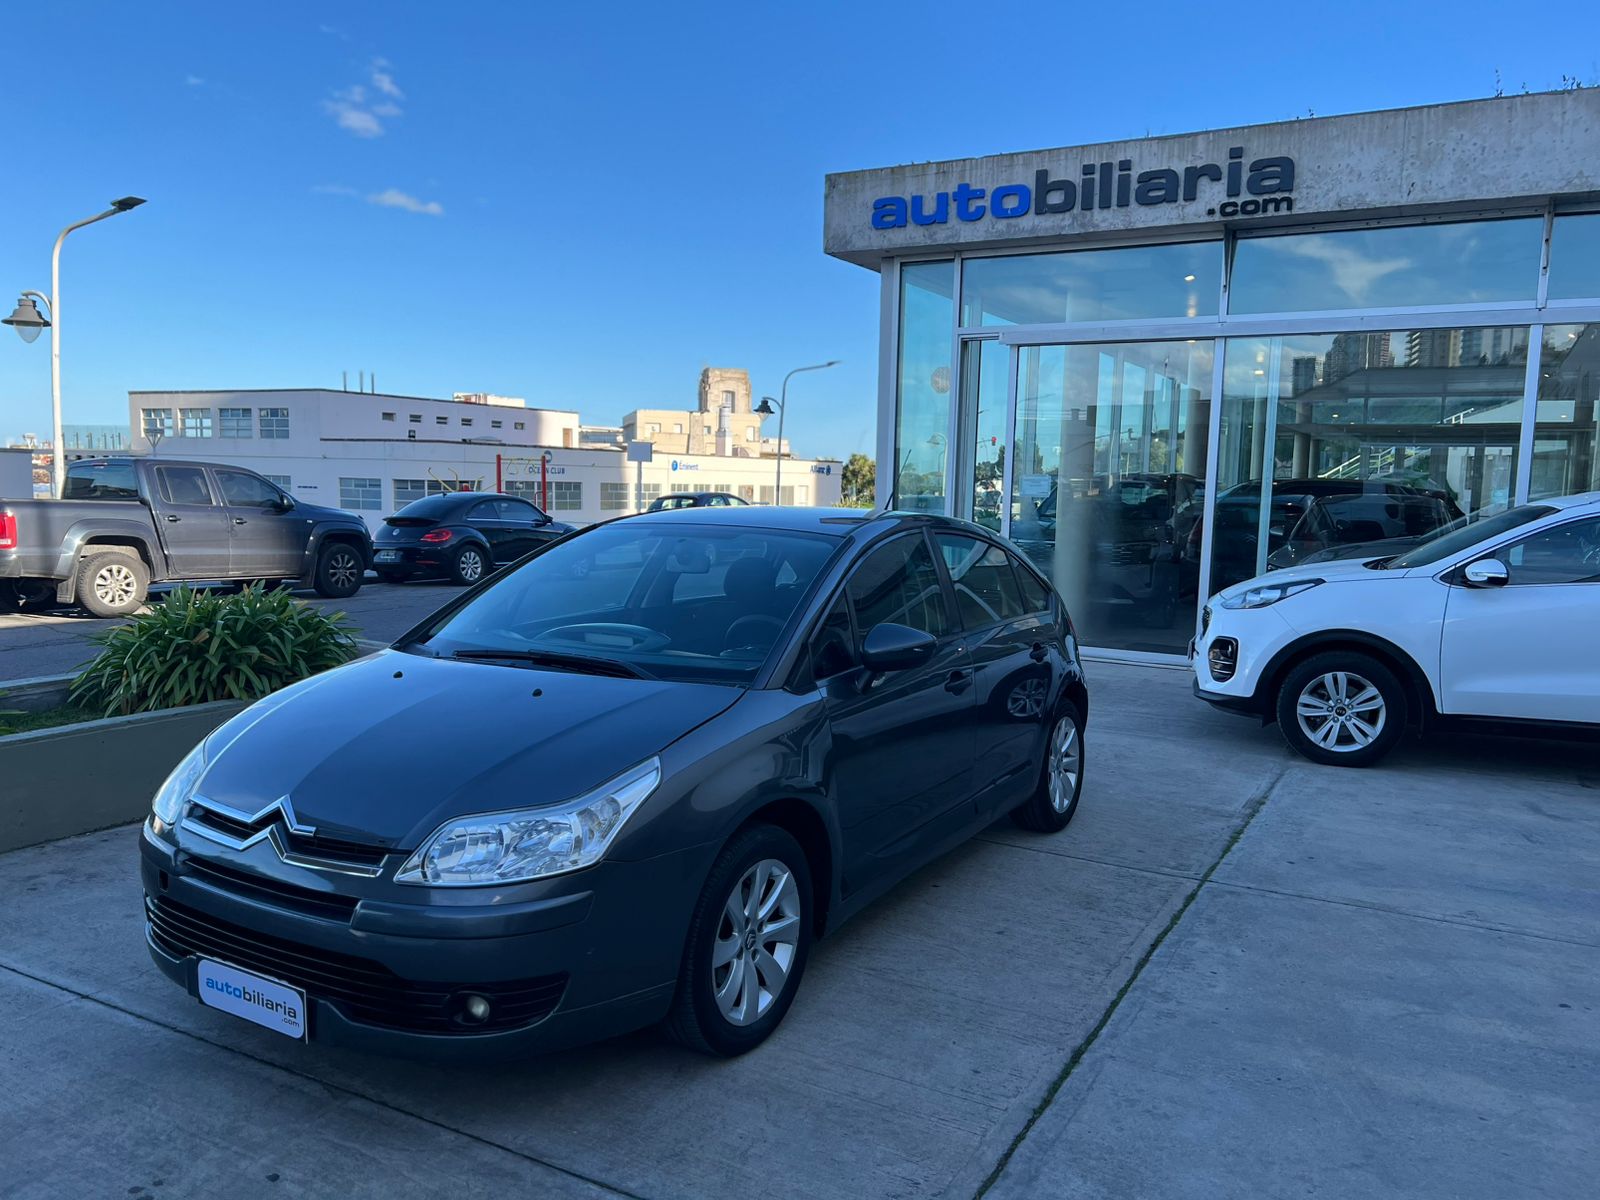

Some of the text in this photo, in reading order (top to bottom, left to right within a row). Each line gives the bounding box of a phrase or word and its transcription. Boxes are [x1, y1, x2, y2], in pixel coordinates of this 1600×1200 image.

[872, 147, 1295, 229] autobiliaria
[1207, 196, 1293, 216] .com
[528, 466, 549, 474] OCEN
[206, 977, 297, 1019] autobiliaria
[281, 1018, 300, 1028] .com
